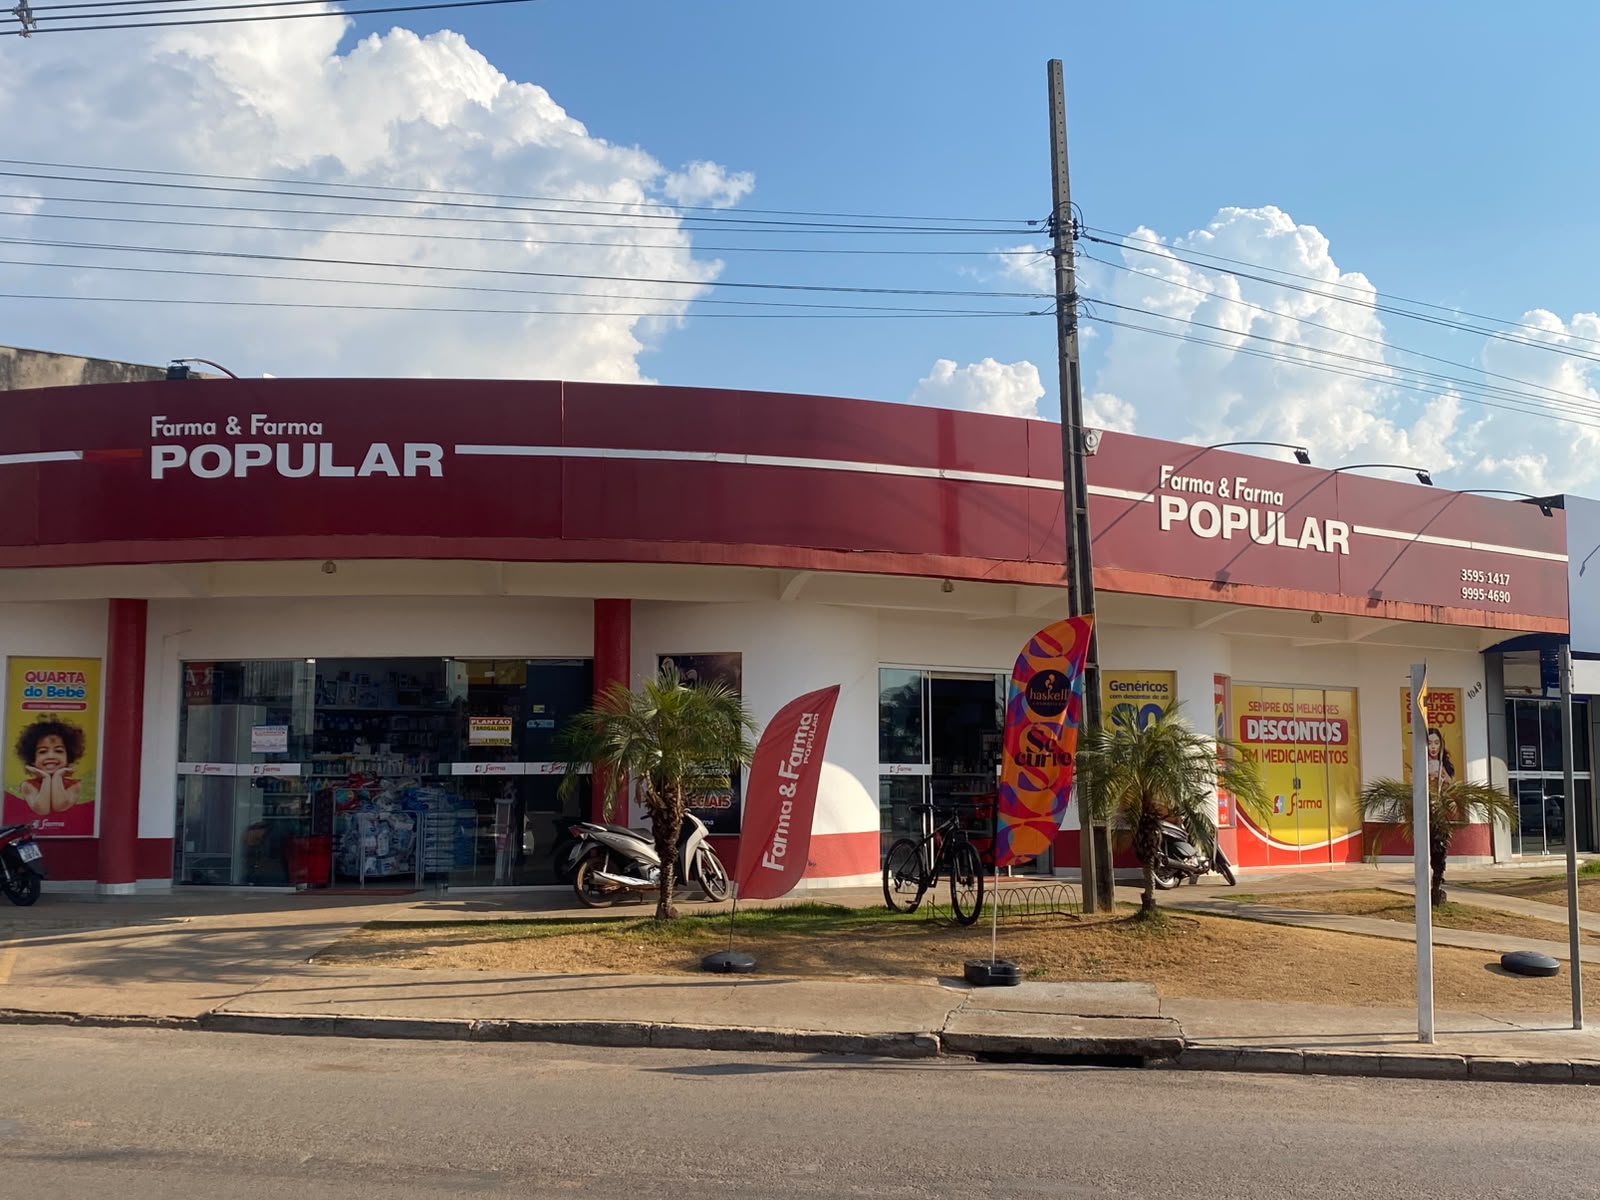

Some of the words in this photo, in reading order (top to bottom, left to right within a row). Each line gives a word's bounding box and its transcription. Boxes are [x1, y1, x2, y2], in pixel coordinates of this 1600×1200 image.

[151, 415, 216, 437] Farma
[225, 416, 241, 436] &
[250, 414, 323, 436] Farma
[150, 443, 444, 479] POPULAR
[1159, 465, 1214, 494] Farma
[1217, 478, 1230, 498] &
[1234, 477, 1284, 506] Farma
[1159, 496, 1350, 555] POPULAR
[1461, 587, 1511, 604] 9995-4690
[25, 671, 86, 684] QUARTA
[1109, 680, 1169, 692] Genéricos
[24, 685, 43, 697] do
[47, 685, 85, 698] Bebê
[1030, 688, 1069, 701] haskell
[1248, 701, 1281, 713] SEMPRE
[1283, 702, 1294, 713] OS
[1296, 703, 1340, 715] MELHORES
[802, 713, 820, 765] POPULAR
[1247, 719, 1342, 742] DESCONTOS
[778, 712, 813, 780] Farma
[1262, 749, 1349, 764] MEDICAMENTOS
[483, 763, 506, 774] farma
[778, 783, 798, 799] &
[1286, 792, 1323, 817] farma
[762, 801, 794, 872] Farma
